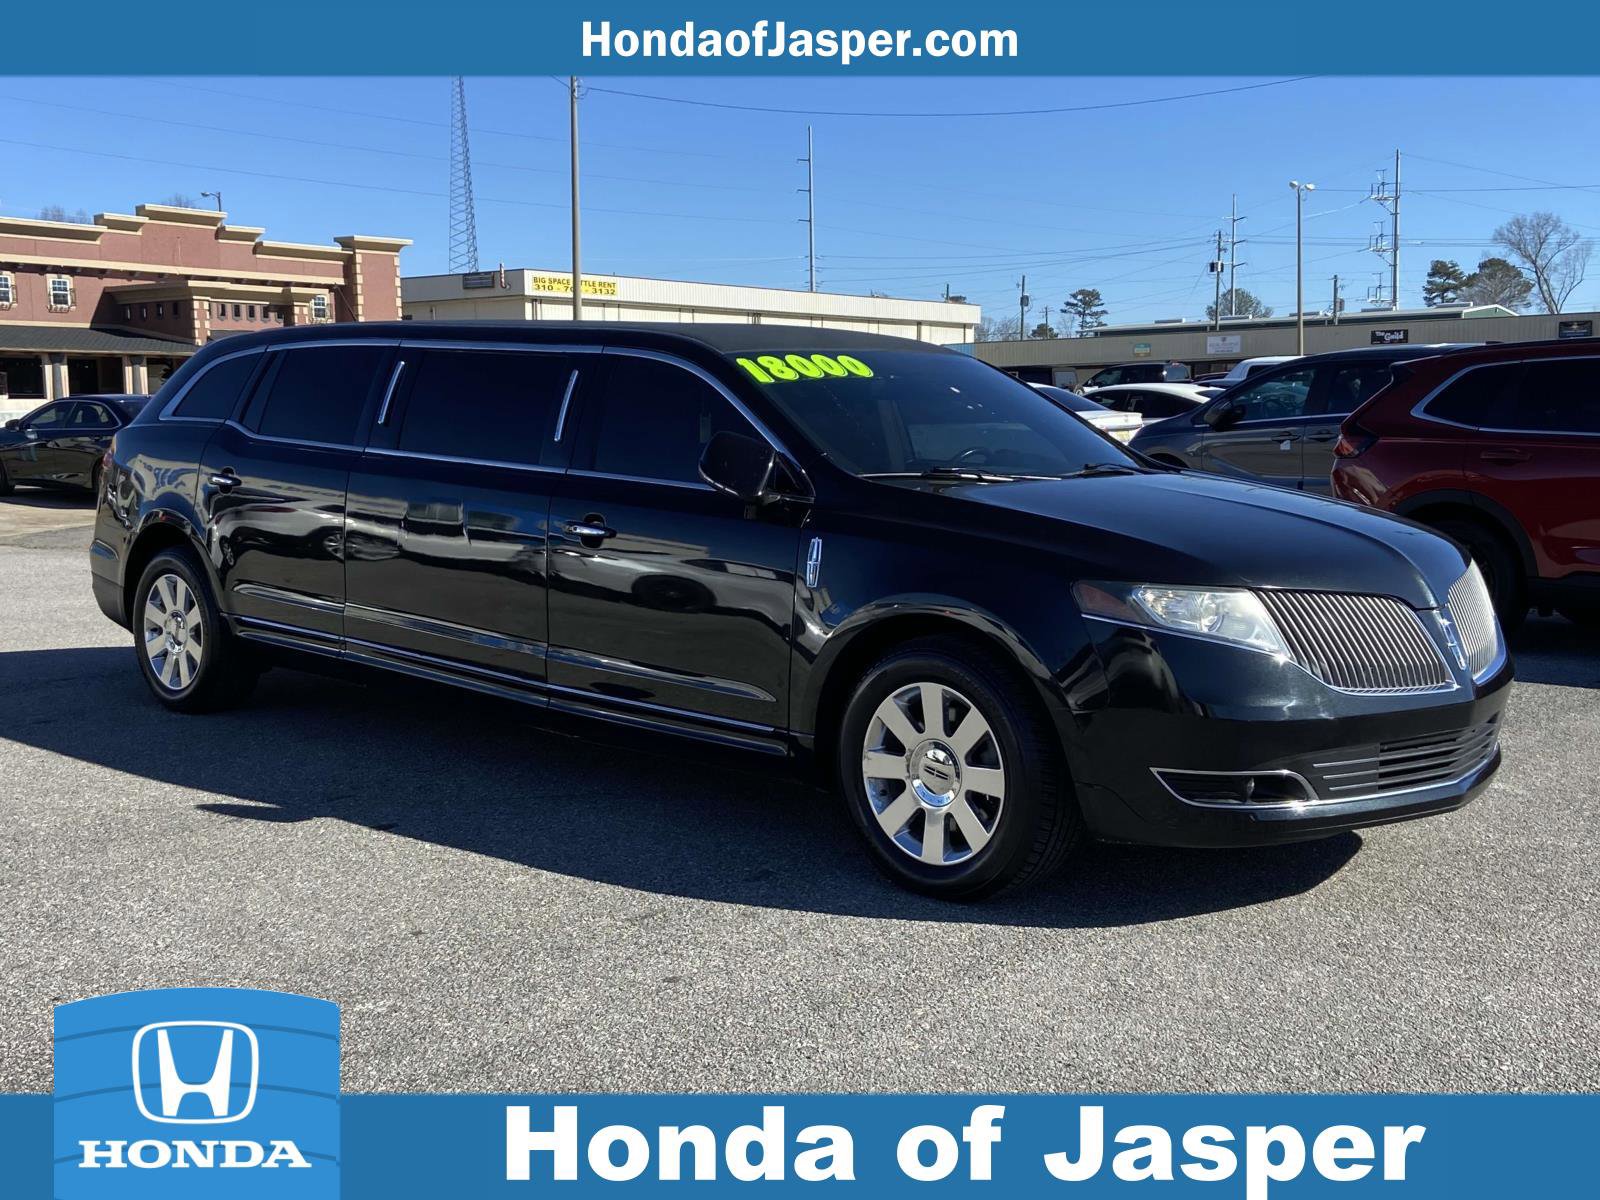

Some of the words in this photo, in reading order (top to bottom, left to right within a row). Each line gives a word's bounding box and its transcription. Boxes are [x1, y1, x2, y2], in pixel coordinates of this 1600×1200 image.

[548, 277, 571, 285] SPACE
[598, 281, 616, 289] RENT
[592, 287, 616, 295] 3132
[736, 355, 873, 383] 18000
